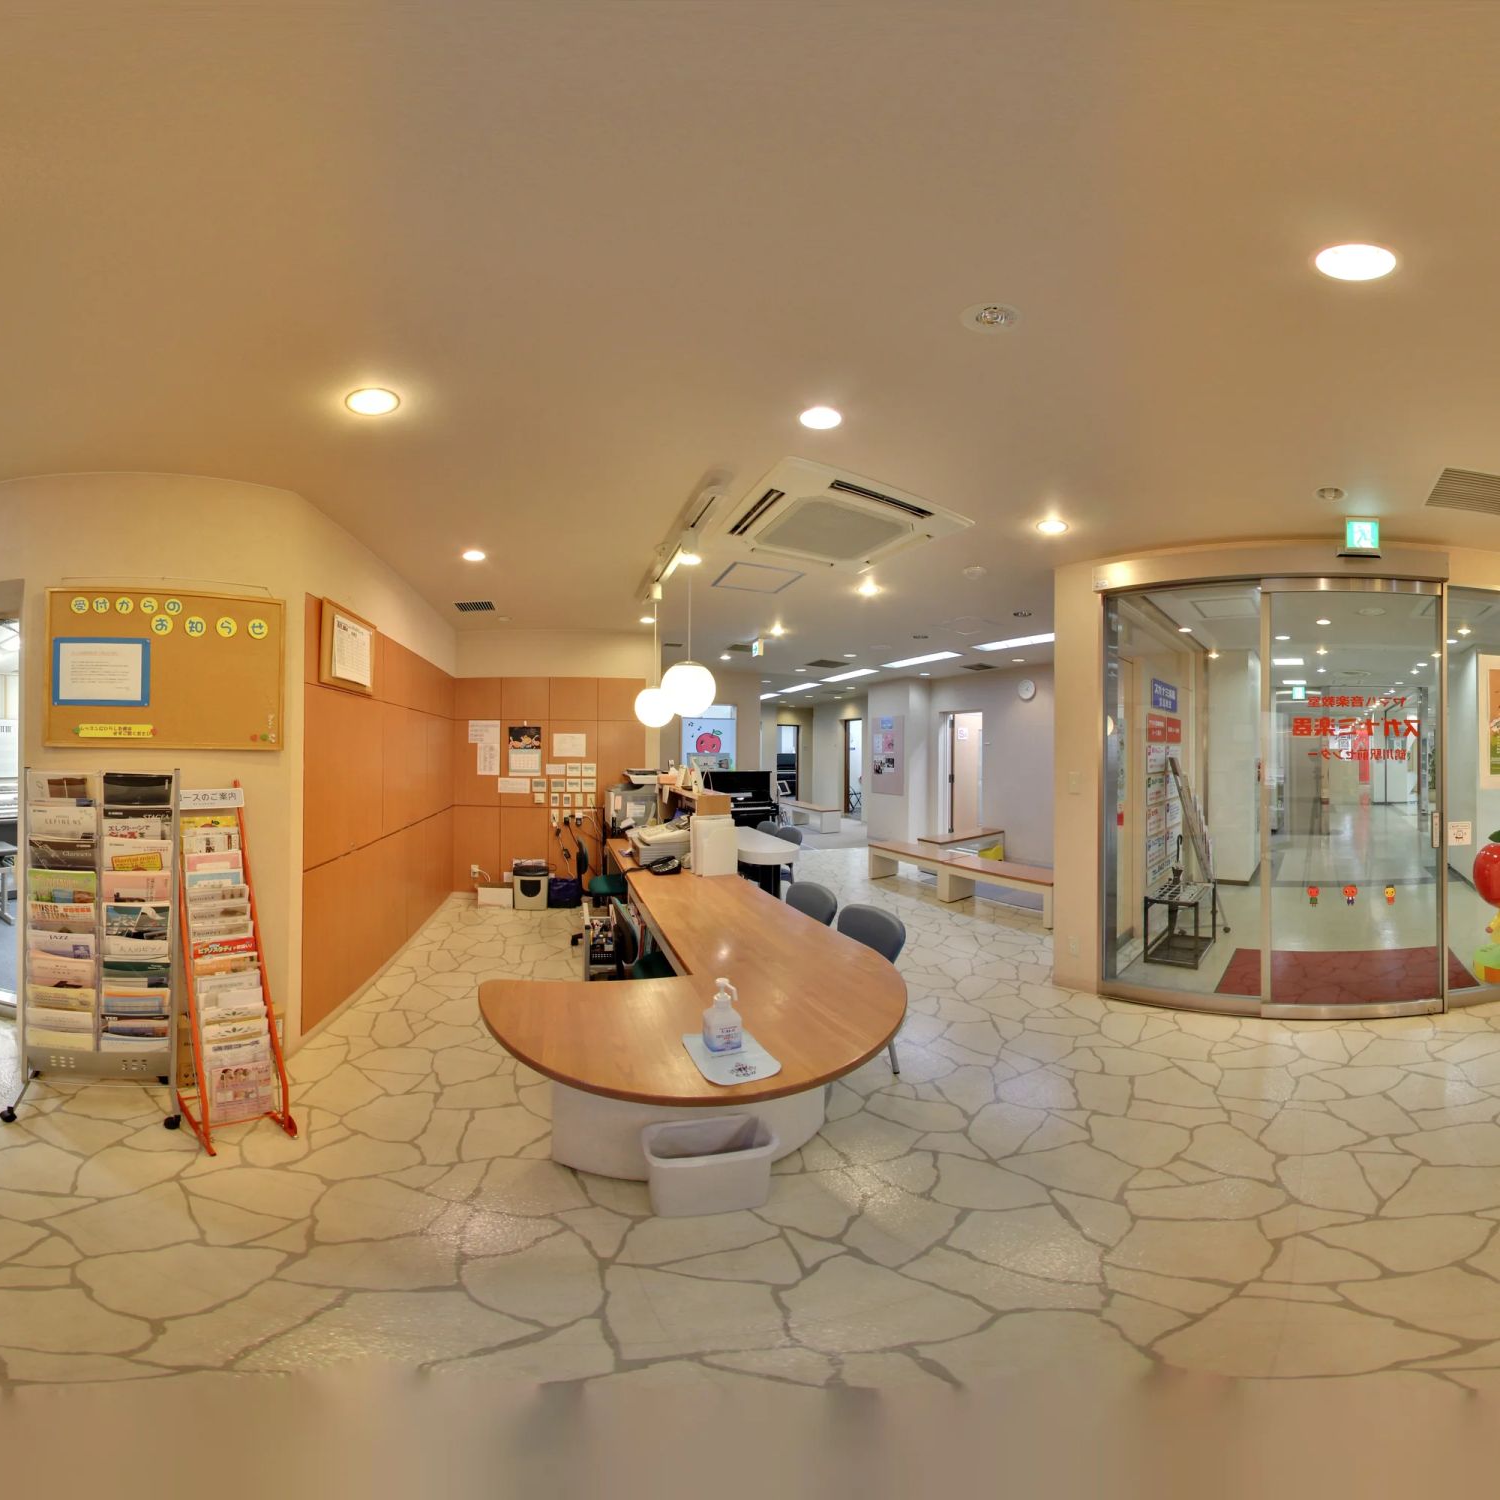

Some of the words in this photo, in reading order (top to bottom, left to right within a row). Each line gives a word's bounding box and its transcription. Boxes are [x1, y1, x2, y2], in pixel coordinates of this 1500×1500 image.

[74, 600, 181, 612] 受付からの
[155, 618, 264, 635] お知らせ
